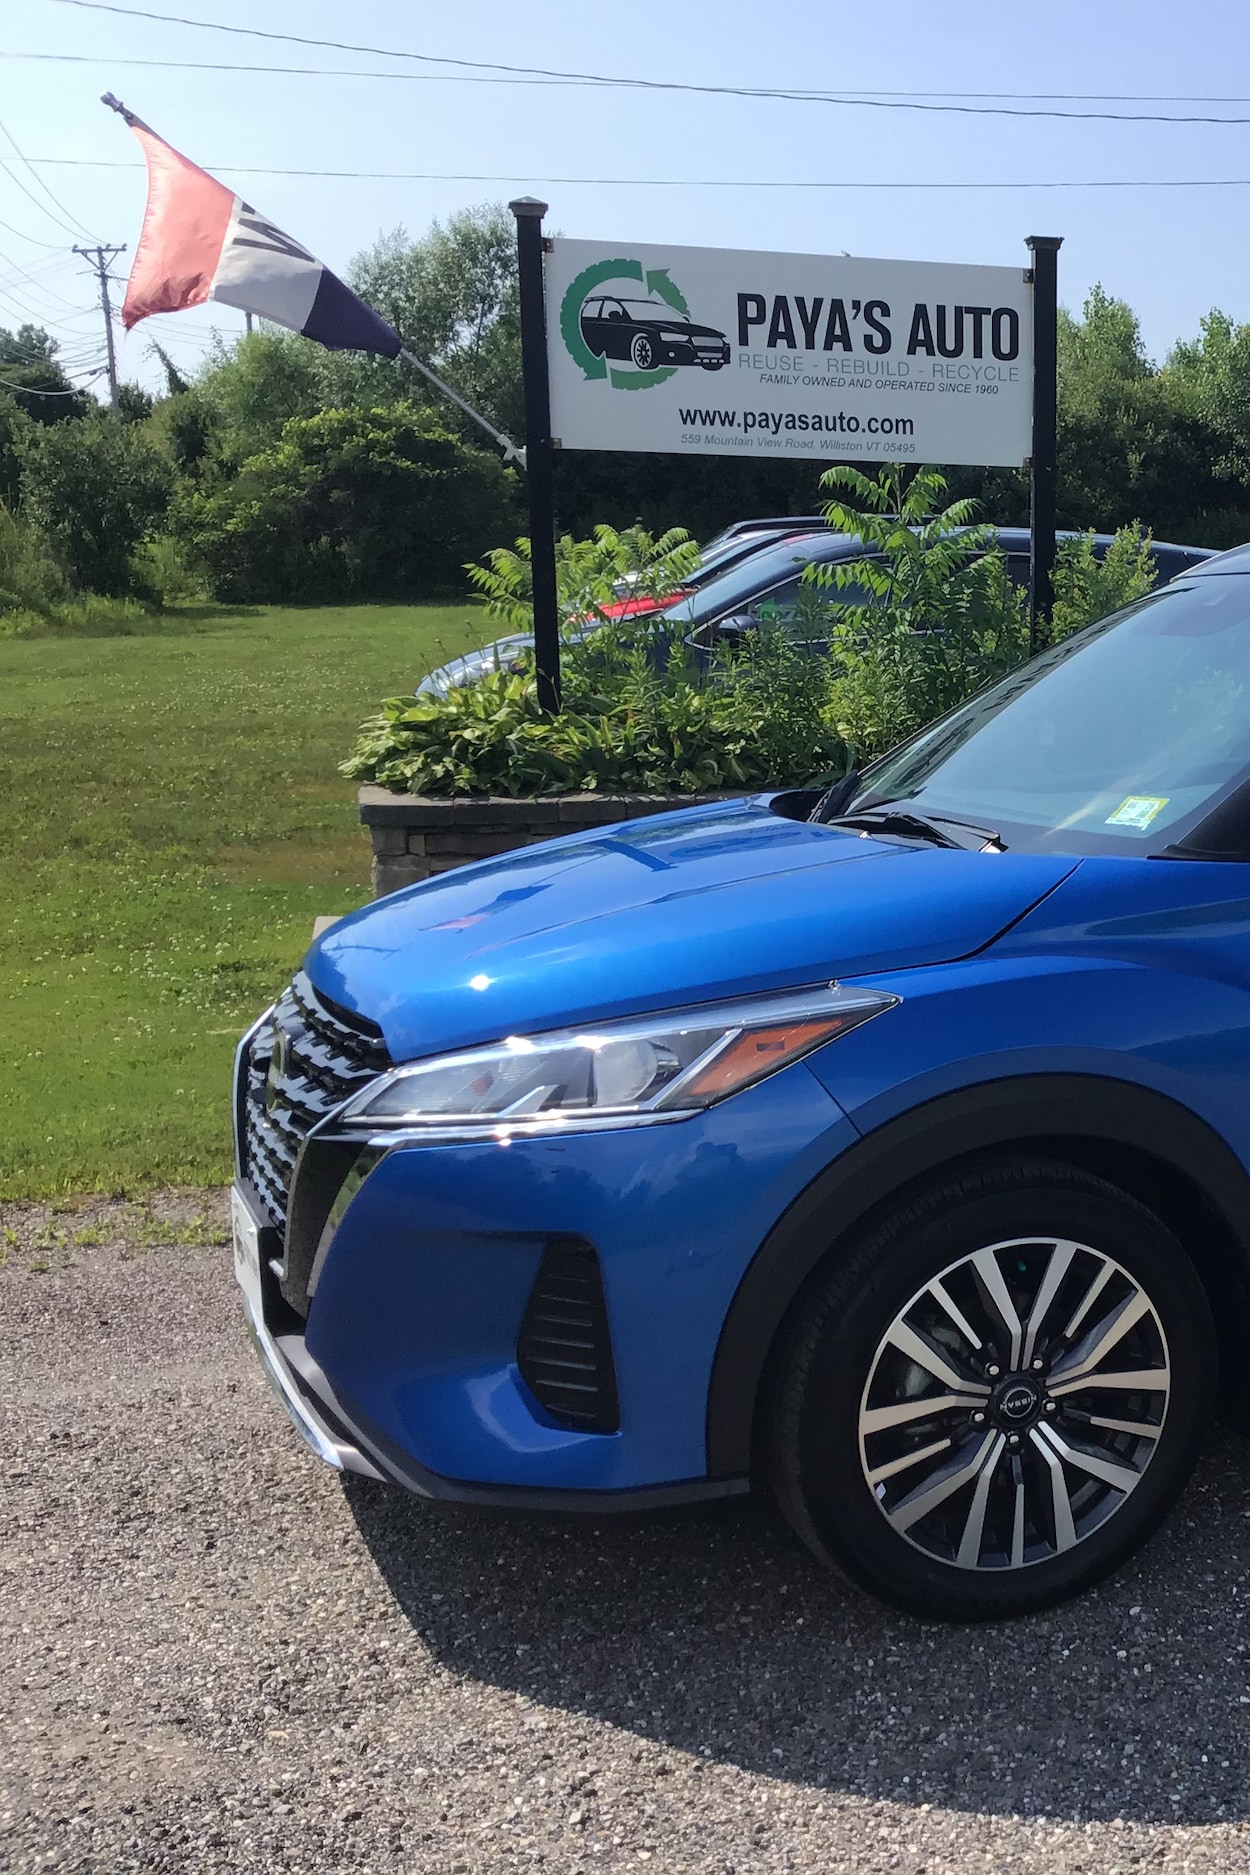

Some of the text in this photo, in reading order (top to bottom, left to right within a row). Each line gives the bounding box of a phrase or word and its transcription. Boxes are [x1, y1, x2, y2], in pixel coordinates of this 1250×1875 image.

[737, 292, 1019, 361] PAYA'S AUTO
[738, 353, 804, 371] REUSE
[827, 357, 910, 376] REBUILD
[932, 363, 1020, 382] RECYCLE
[759, 373, 999, 395] FAMILY OWNED AND OPERATED SINCE 1960
[678, 408, 914, 435] www.payasauto.com
[681, 433, 701, 444] 559
[704, 434, 753, 446] Mountain
[757, 437, 783, 448] View
[820, 440, 863, 451] Williston
[866, 441, 882, 452] VT
[883, 442, 916, 453] 05495
[1000, 1395, 1037, 1411] NISSAN
